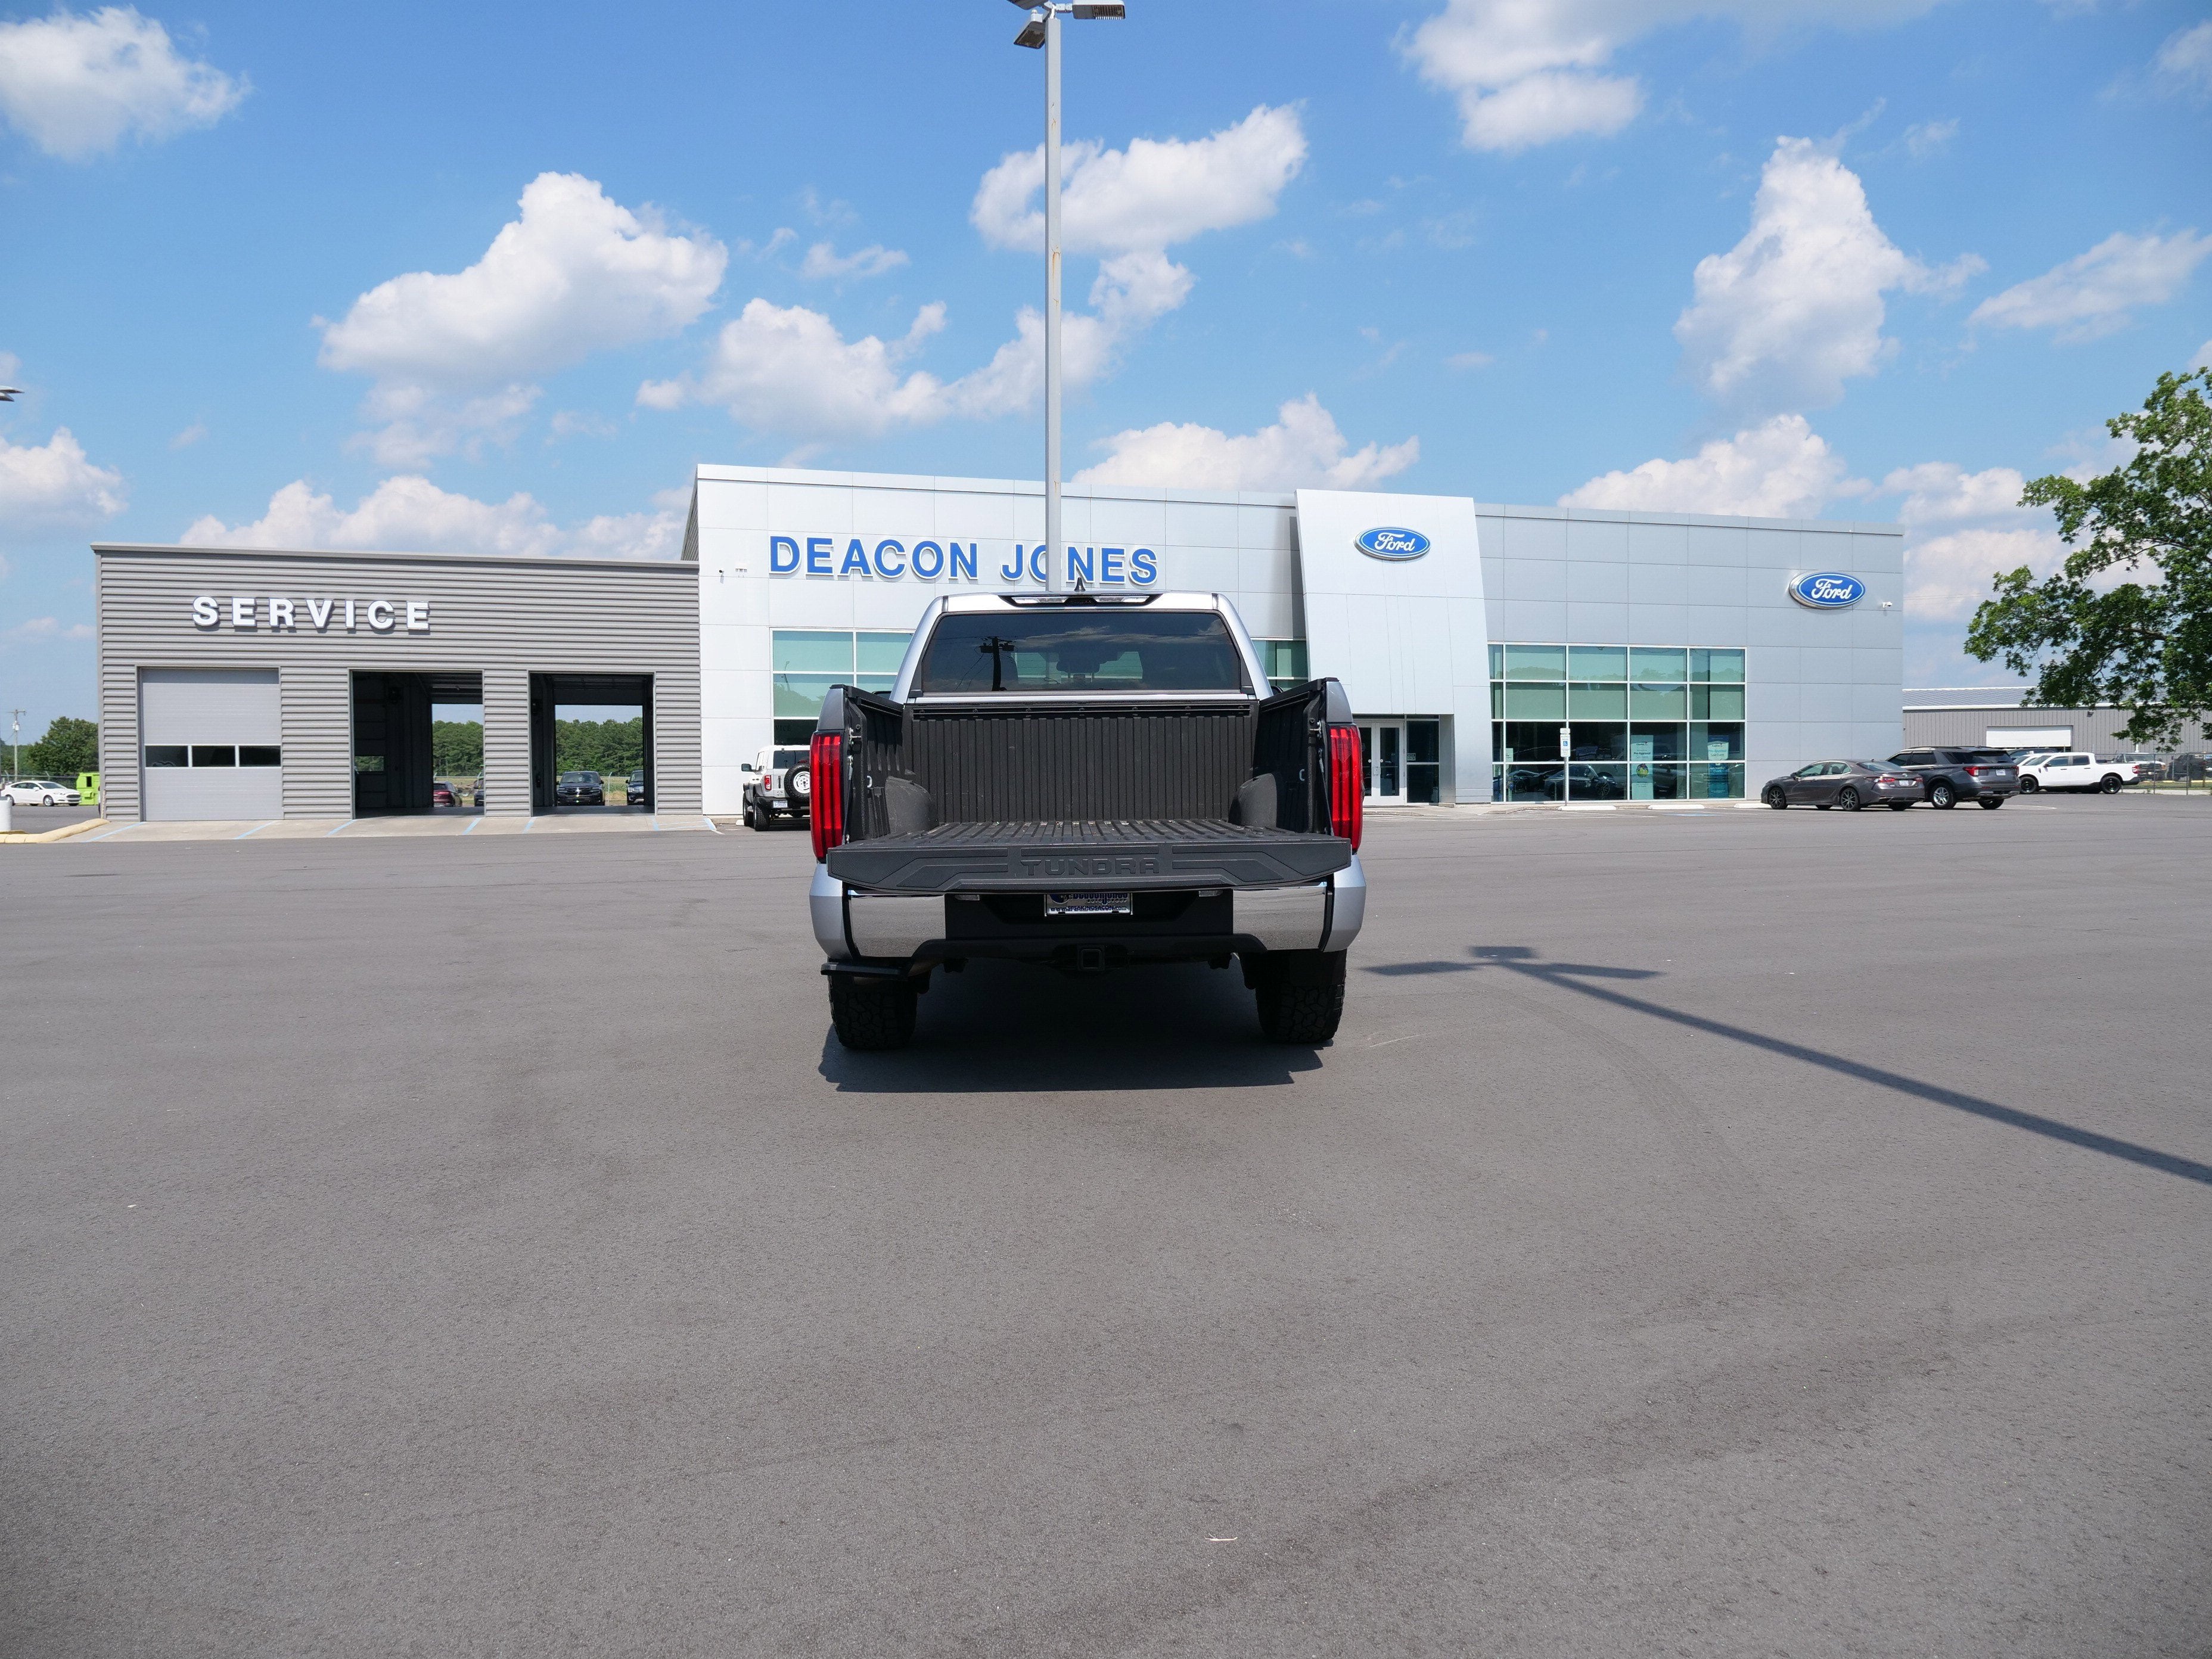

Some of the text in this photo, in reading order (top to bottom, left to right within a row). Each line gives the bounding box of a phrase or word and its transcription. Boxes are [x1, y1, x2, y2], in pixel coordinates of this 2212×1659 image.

[1374, 532, 1415, 551] Ford
[769, 535, 1158, 585] DEACON JONES
[1812, 578, 1853, 599] Ford
[192, 596, 430, 630] SERVICE
[1020, 858, 1160, 876] TUNDRA
